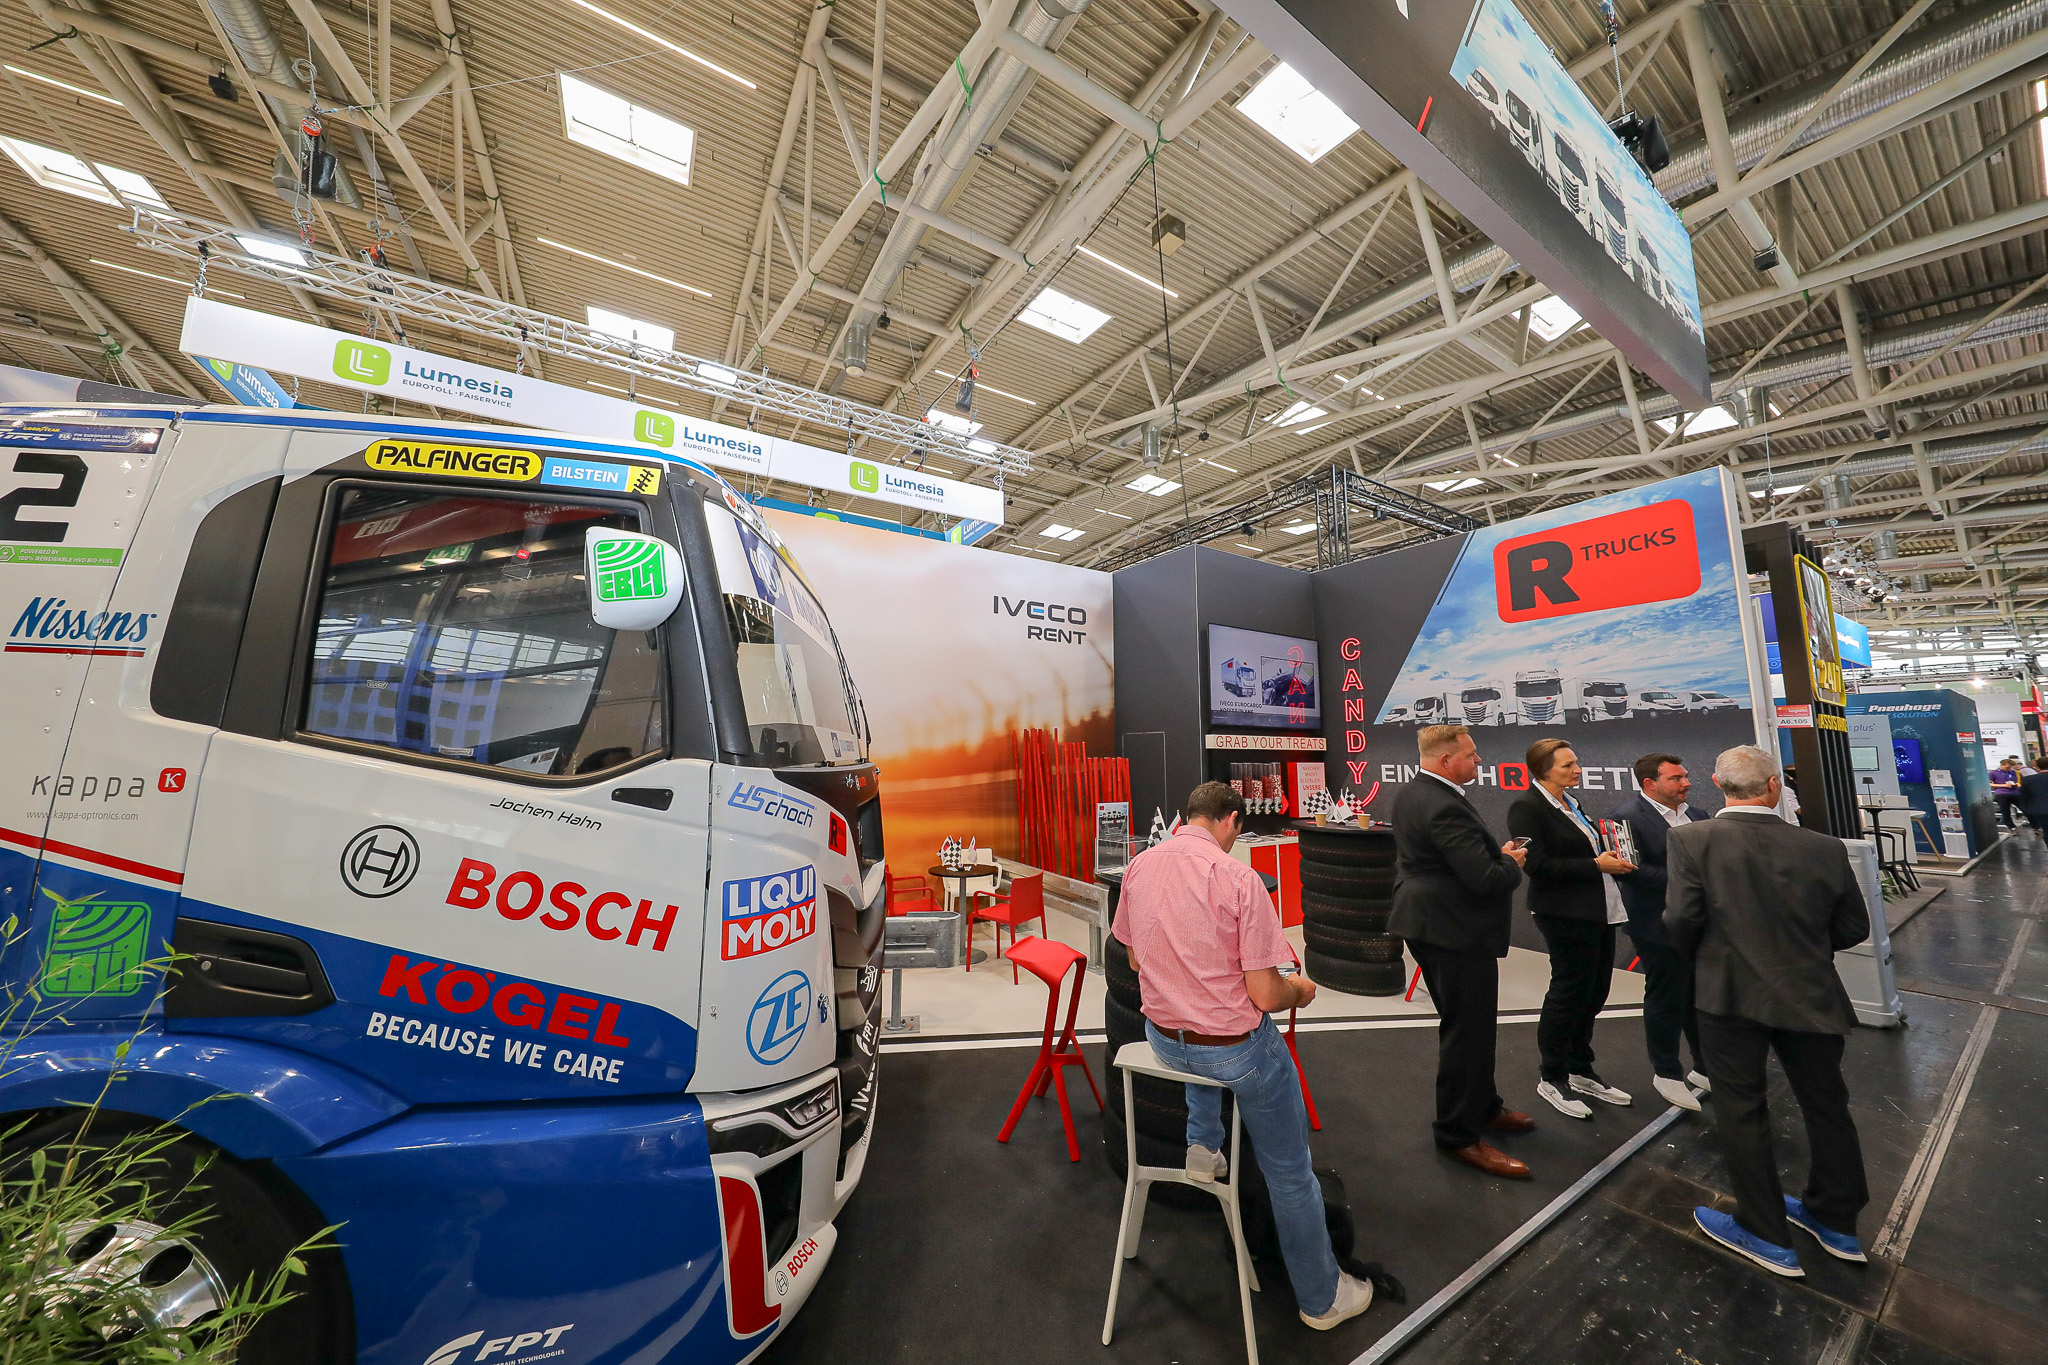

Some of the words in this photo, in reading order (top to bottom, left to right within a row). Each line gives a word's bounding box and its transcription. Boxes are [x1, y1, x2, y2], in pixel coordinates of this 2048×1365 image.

[237, 364, 280, 408] Lumesia
[402, 360, 513, 398] Lumesia
[402, 378, 453, 395] EUROTOLL
[458, 390, 512, 408] FAISERVICE
[683, 426, 762, 457] Lumesia
[375, 444, 532, 477] PALFINGER
[550, 465, 620, 484] BILSTEIN
[0, 452, 89, 543] 2
[885, 473, 944, 497] Lumesia
[1507, 540, 1581, 612] R
[1579, 528, 1677, 561] TRUCKS
[9, 597, 152, 643] Nissens
[993, 595, 1087, 626] IVECO
[1027, 625, 1087, 645] RENT
[1340, 637, 1368, 785] CANDY
[1868, 703, 1942, 712] Pneuhage
[1891, 711, 1939, 719] SOLUTION
[1215, 735, 1249, 748] GRAB
[1252, 736, 1283, 749] YOUR
[1287, 737, 1325, 750] TREATS
[26, 810, 139, 821] www.kappa-optronics.com
[490, 797, 554, 820] Jochen
[556, 811, 603, 831] Hahn
[445, 857, 680, 952] BOSCH
[729, 867, 815, 917] LIQUI
[727, 901, 816, 957] MOLY
[378, 954, 631, 1048] KÖGEL
[366, 1011, 495, 1059] BECAUSE
[503, 1037, 547, 1069] WE
[552, 1049, 625, 1084] CARE
[786, 1237, 819, 1278] BOSCH
[473, 1323, 575, 1362] FPT
[518, 1348, 566, 1364] TECHNOLOGIES
